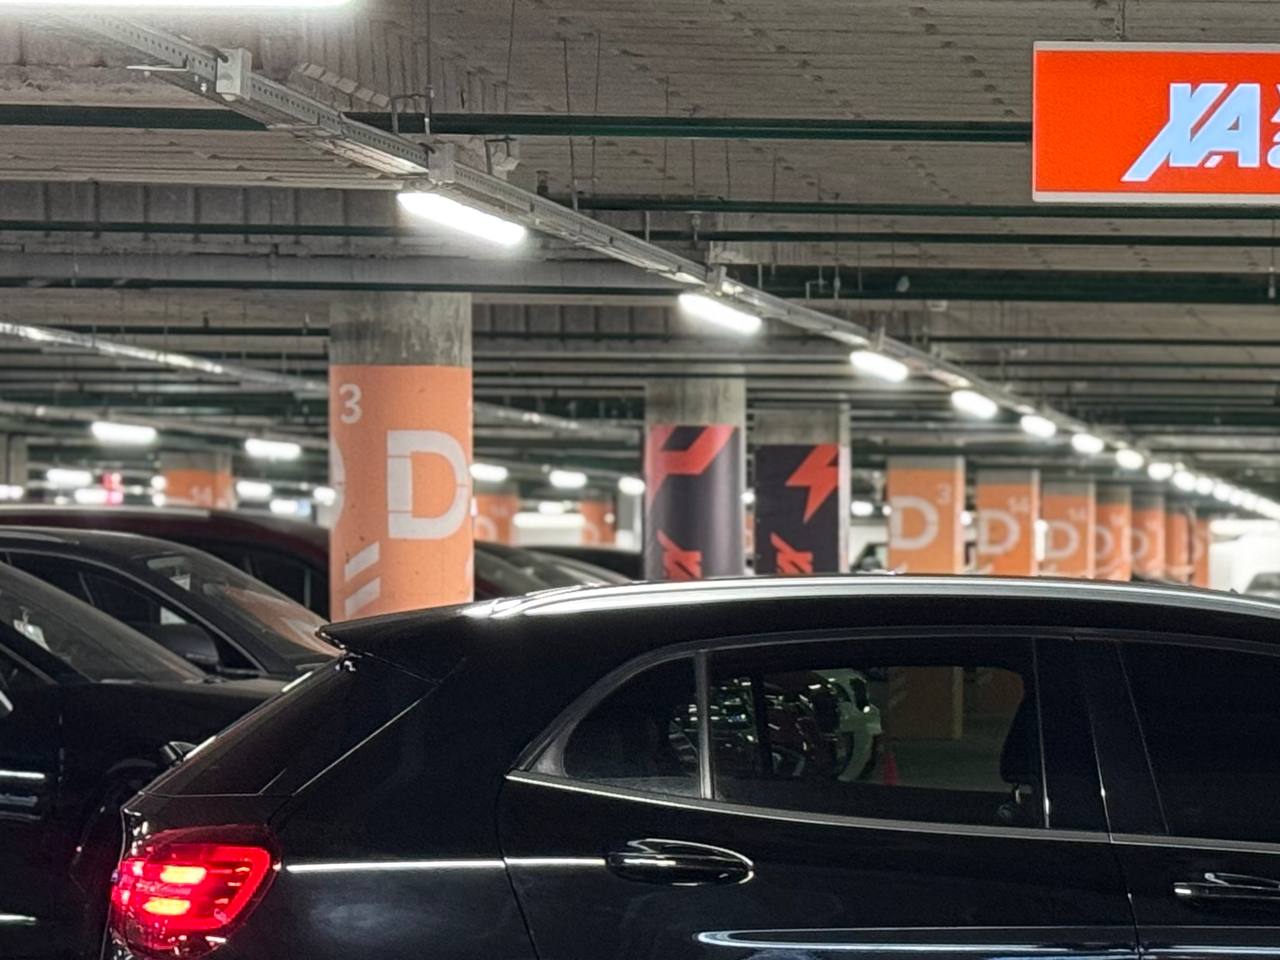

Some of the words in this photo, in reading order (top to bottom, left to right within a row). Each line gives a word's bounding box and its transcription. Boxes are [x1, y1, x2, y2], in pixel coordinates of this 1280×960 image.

[338, 383, 363, 425] 3
[386, 429, 470, 540] D
[889, 495, 940, 550] D
[977, 508, 1021, 556] D
[1045, 519, 1080, 561] D
